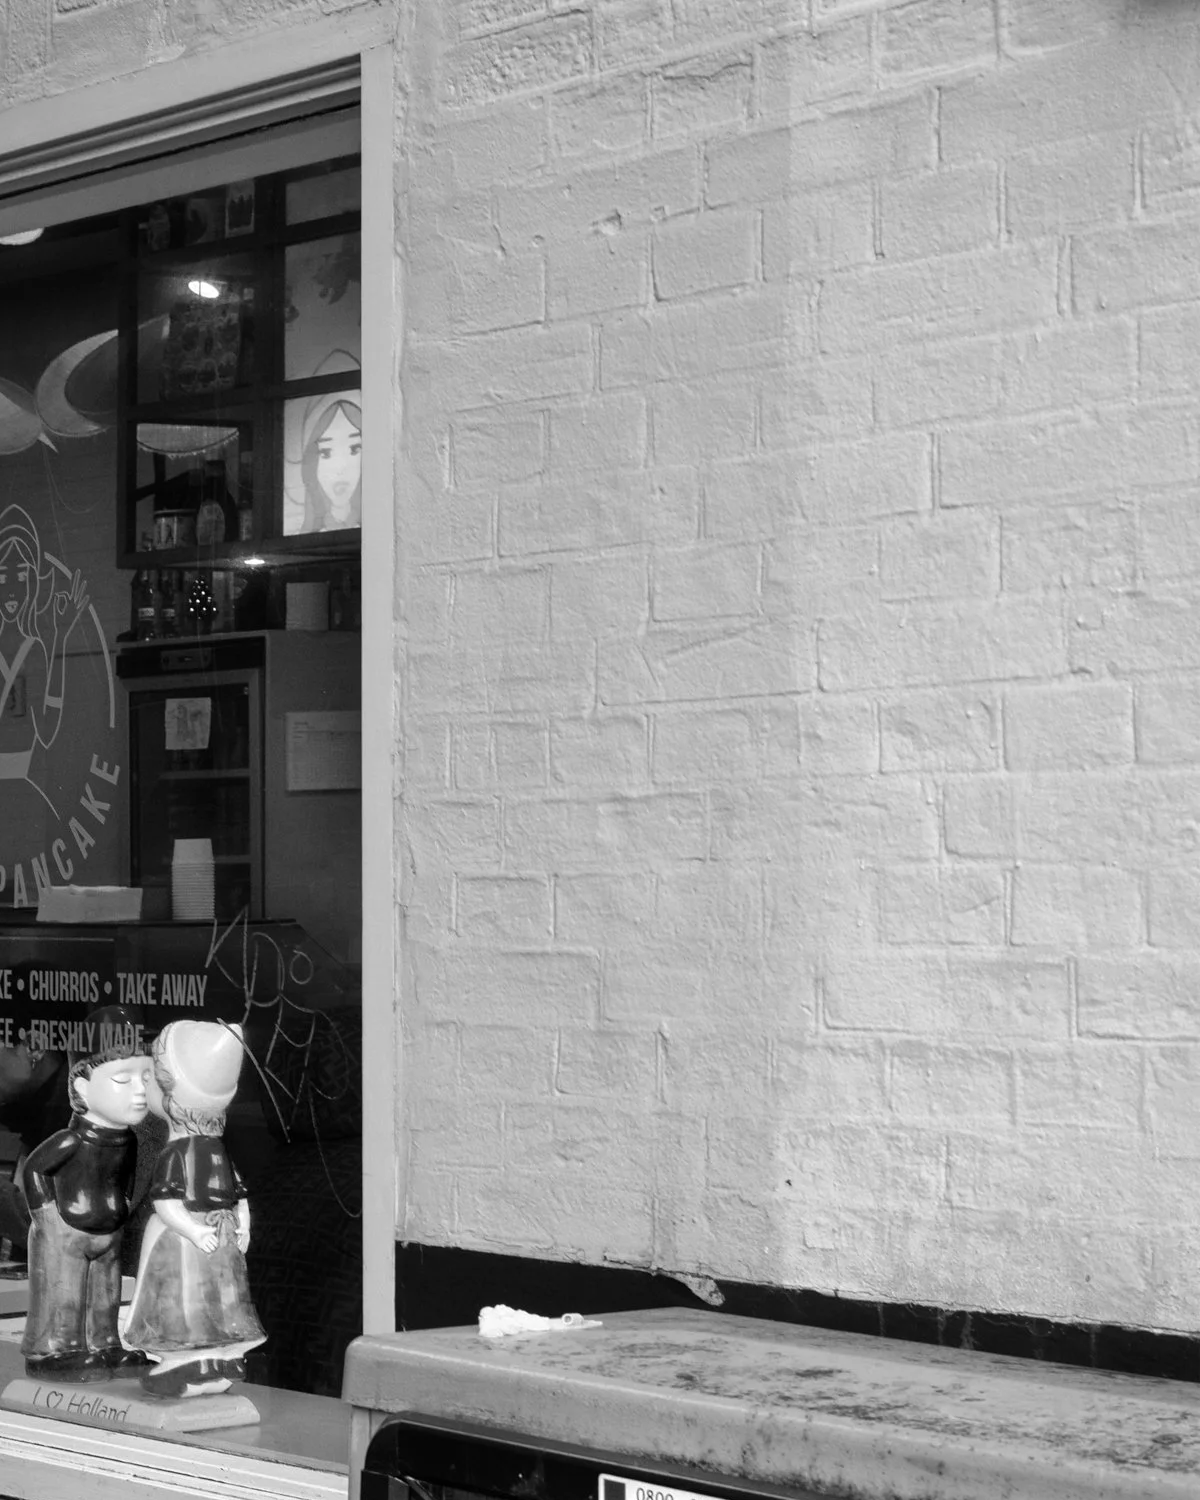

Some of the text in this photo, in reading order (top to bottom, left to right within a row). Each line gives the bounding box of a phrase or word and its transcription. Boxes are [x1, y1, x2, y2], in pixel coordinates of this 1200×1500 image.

[28, 970, 100, 1003] CHURROS
[116, 972, 157, 1006] TAKE
[160, 973, 208, 1007] AWAY
[29, 1019, 96, 1053] FRESHLY
[99, 1022, 145, 1057] MADE
[67, 1392, 133, 1423] Holland
